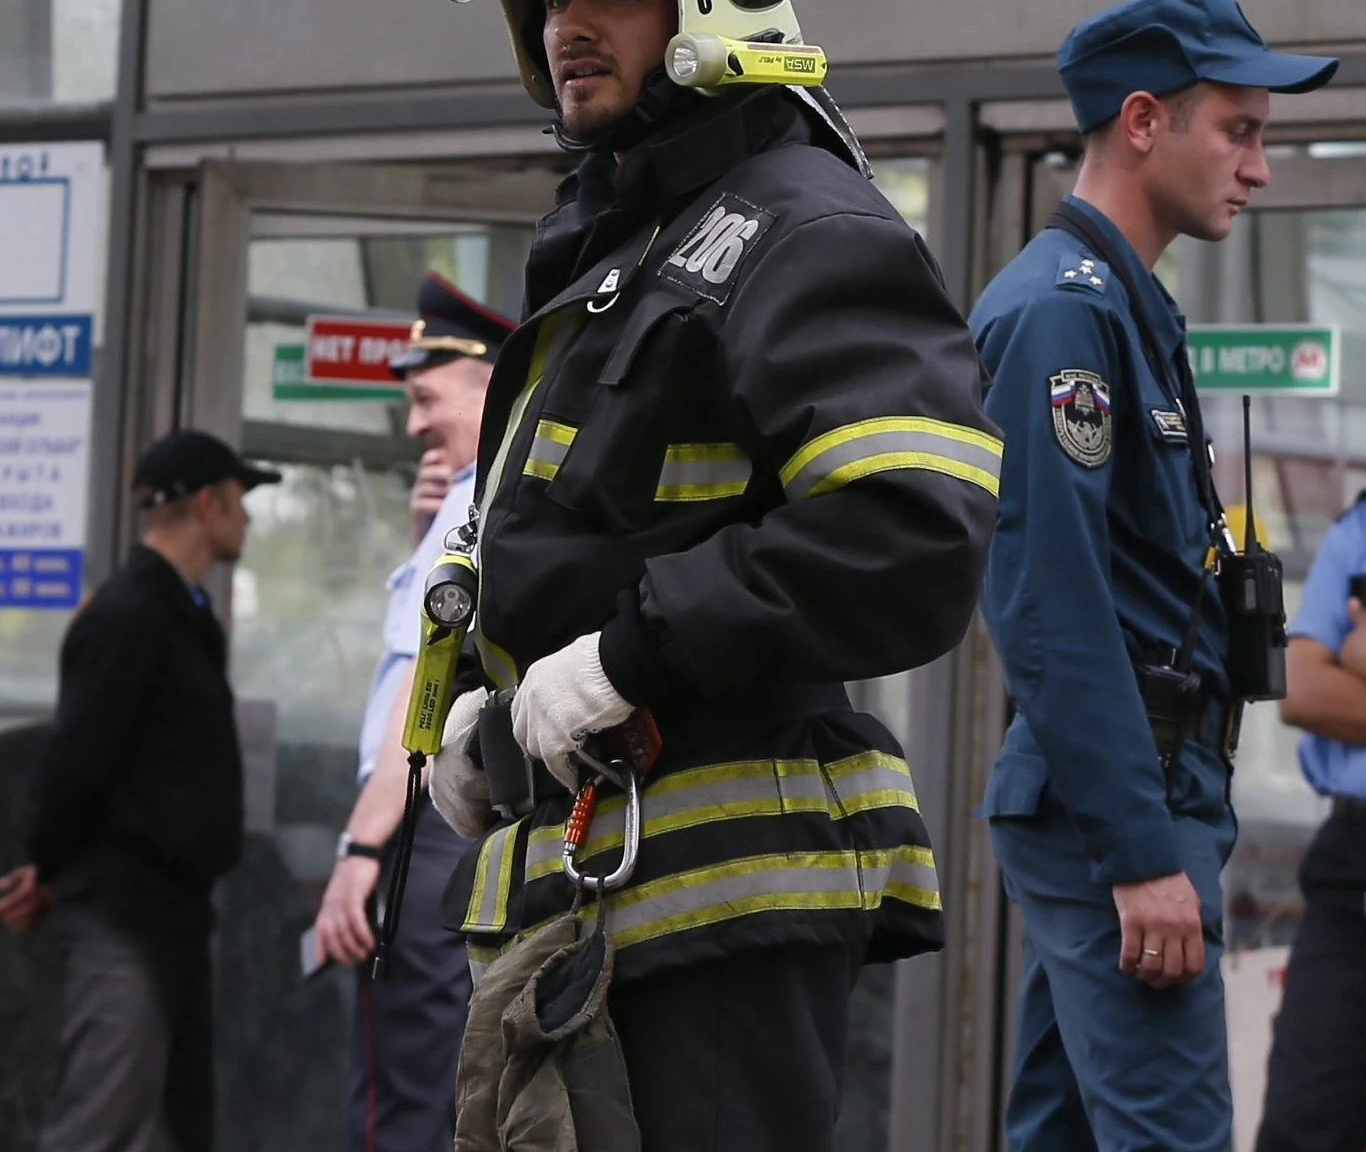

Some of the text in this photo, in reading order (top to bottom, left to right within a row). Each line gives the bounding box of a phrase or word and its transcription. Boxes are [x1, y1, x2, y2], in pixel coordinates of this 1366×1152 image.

[784, 57, 815, 72] MSA
[668, 205, 760, 285] 206
[314, 334, 355, 363] НЕТ
[1217, 345, 1286, 375] МЕТРО
